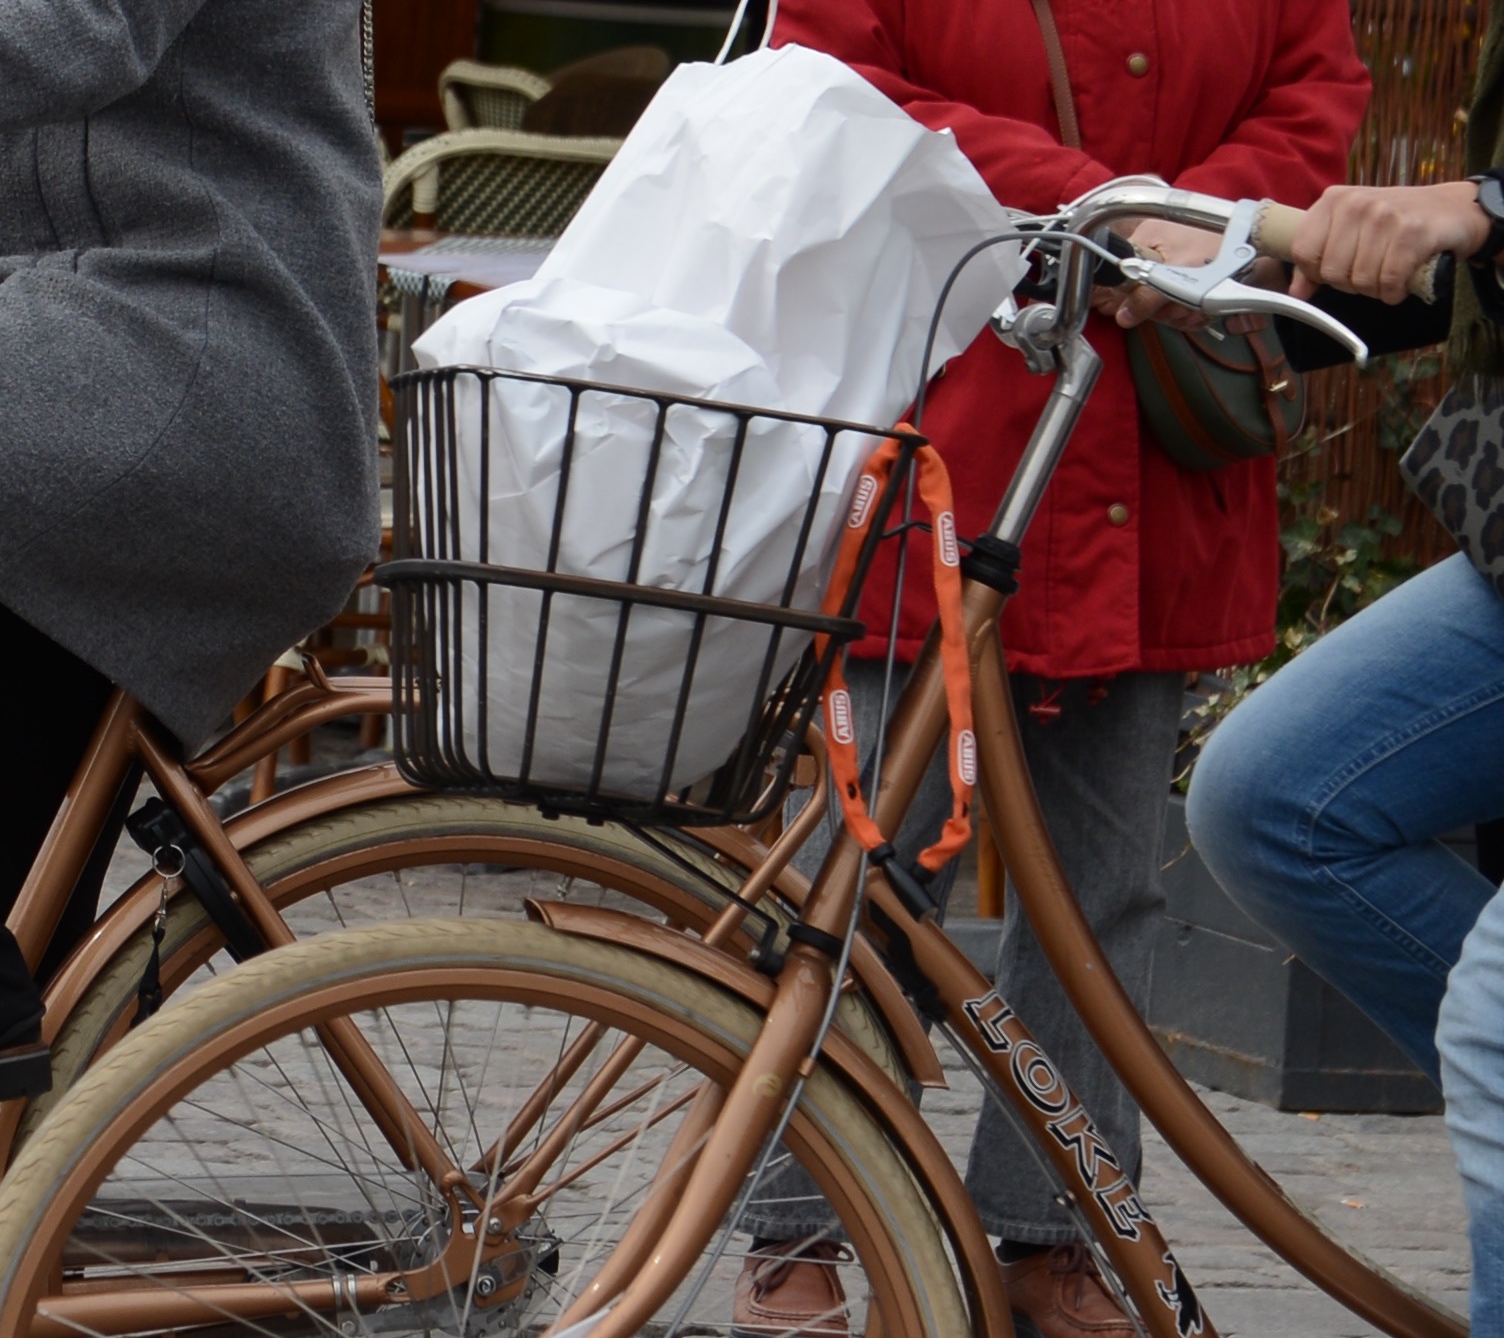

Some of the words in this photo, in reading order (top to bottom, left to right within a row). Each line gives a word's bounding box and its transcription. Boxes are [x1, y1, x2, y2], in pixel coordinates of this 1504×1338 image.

[851, 477, 874, 526] ABUS
[942, 514, 957, 564] ABUS
[834, 693, 851, 739] ABUS
[962, 733, 976, 780] ABUS
[963, 990, 1154, 1242] LOKE
